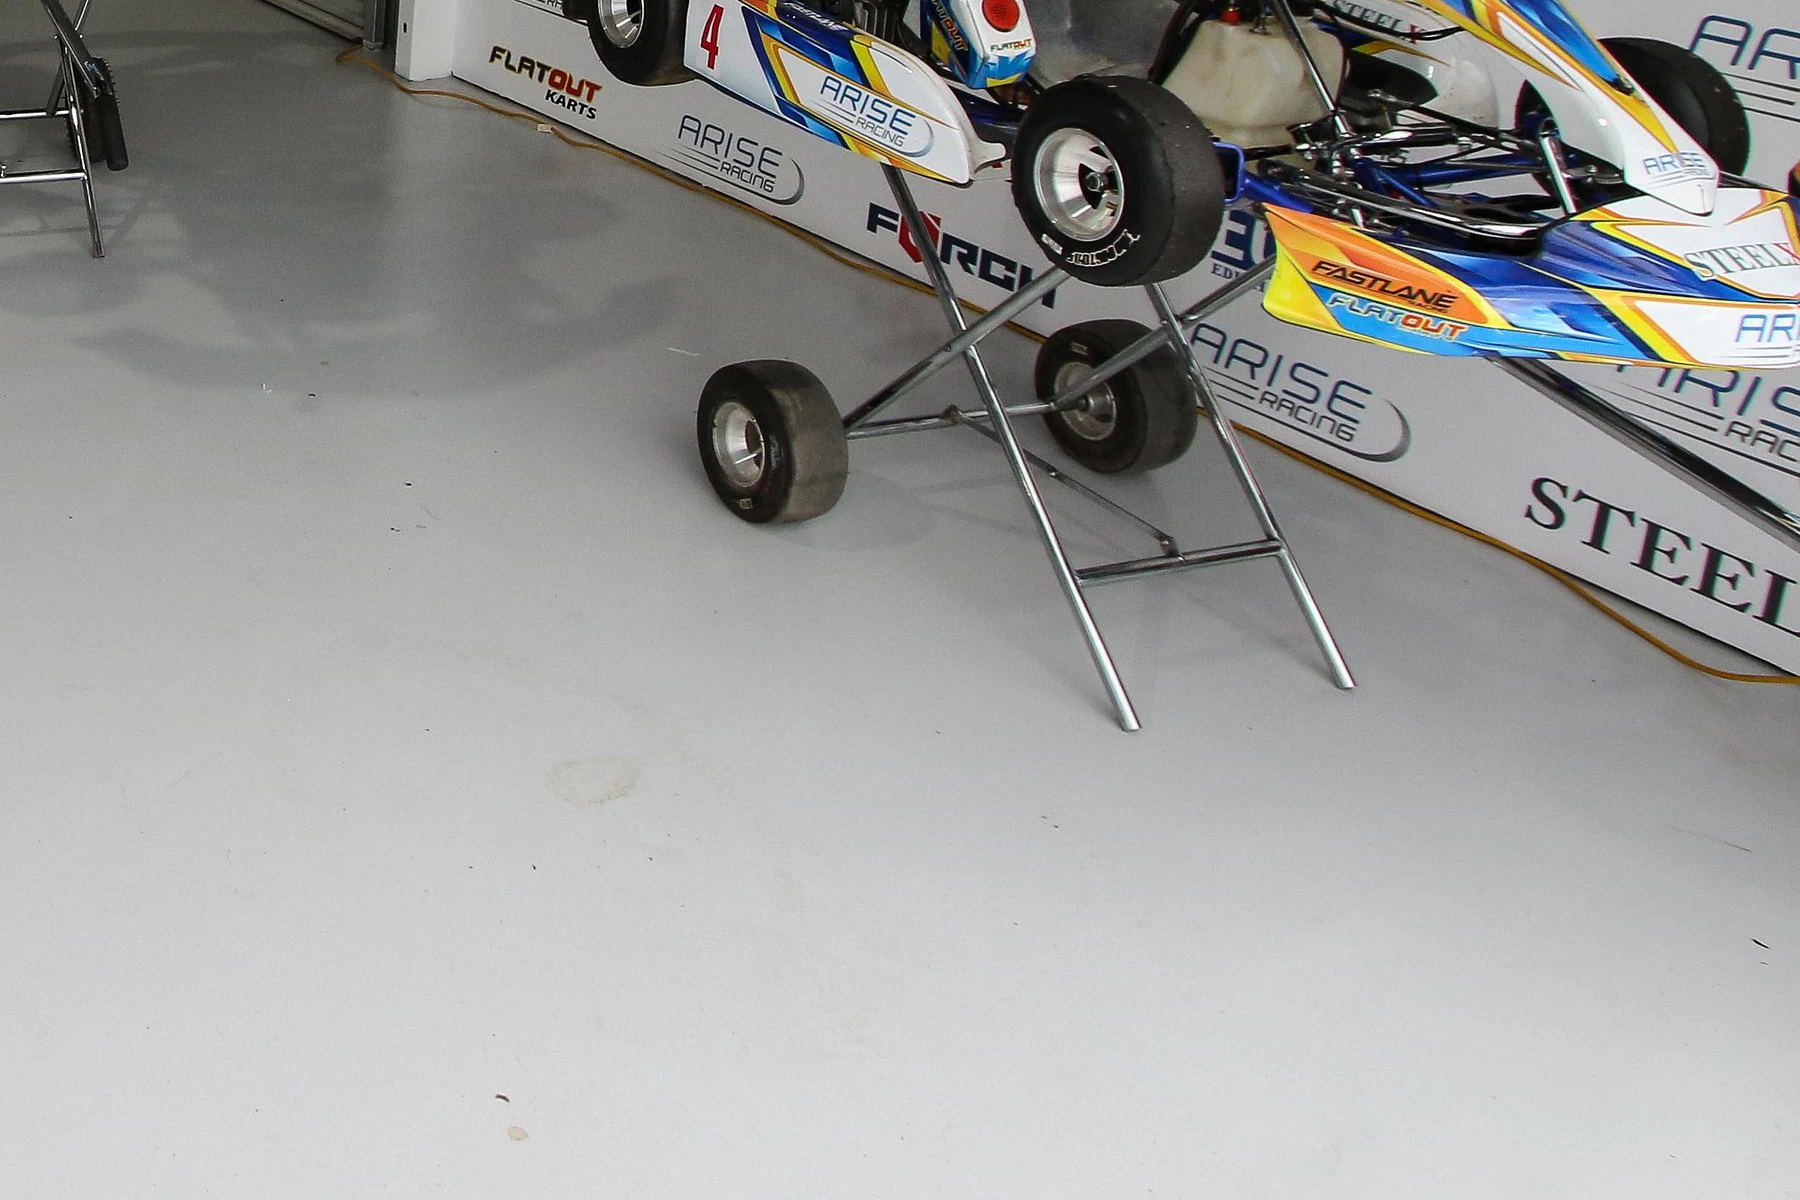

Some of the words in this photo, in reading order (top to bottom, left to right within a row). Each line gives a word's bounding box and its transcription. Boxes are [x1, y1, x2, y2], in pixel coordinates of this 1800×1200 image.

[701, 3, 724, 70] 4
[990, 39, 1032, 52] FLATOUT
[488, 46, 602, 99] FLATOUT
[545, 88, 598, 121] KARTS
[820, 75, 917, 134] ARISE
[678, 115, 784, 175] ARISE
[857, 117, 906, 148] RACING
[721, 163, 775, 194] RACING
[1642, 152, 1706, 175] ARISE
[1312, 260, 1459, 309] FASTLANE
[1328, 292, 1470, 342] FLATOUT
[1192, 325, 1372, 425] ARISE
[1259, 390, 1356, 443] RACING
